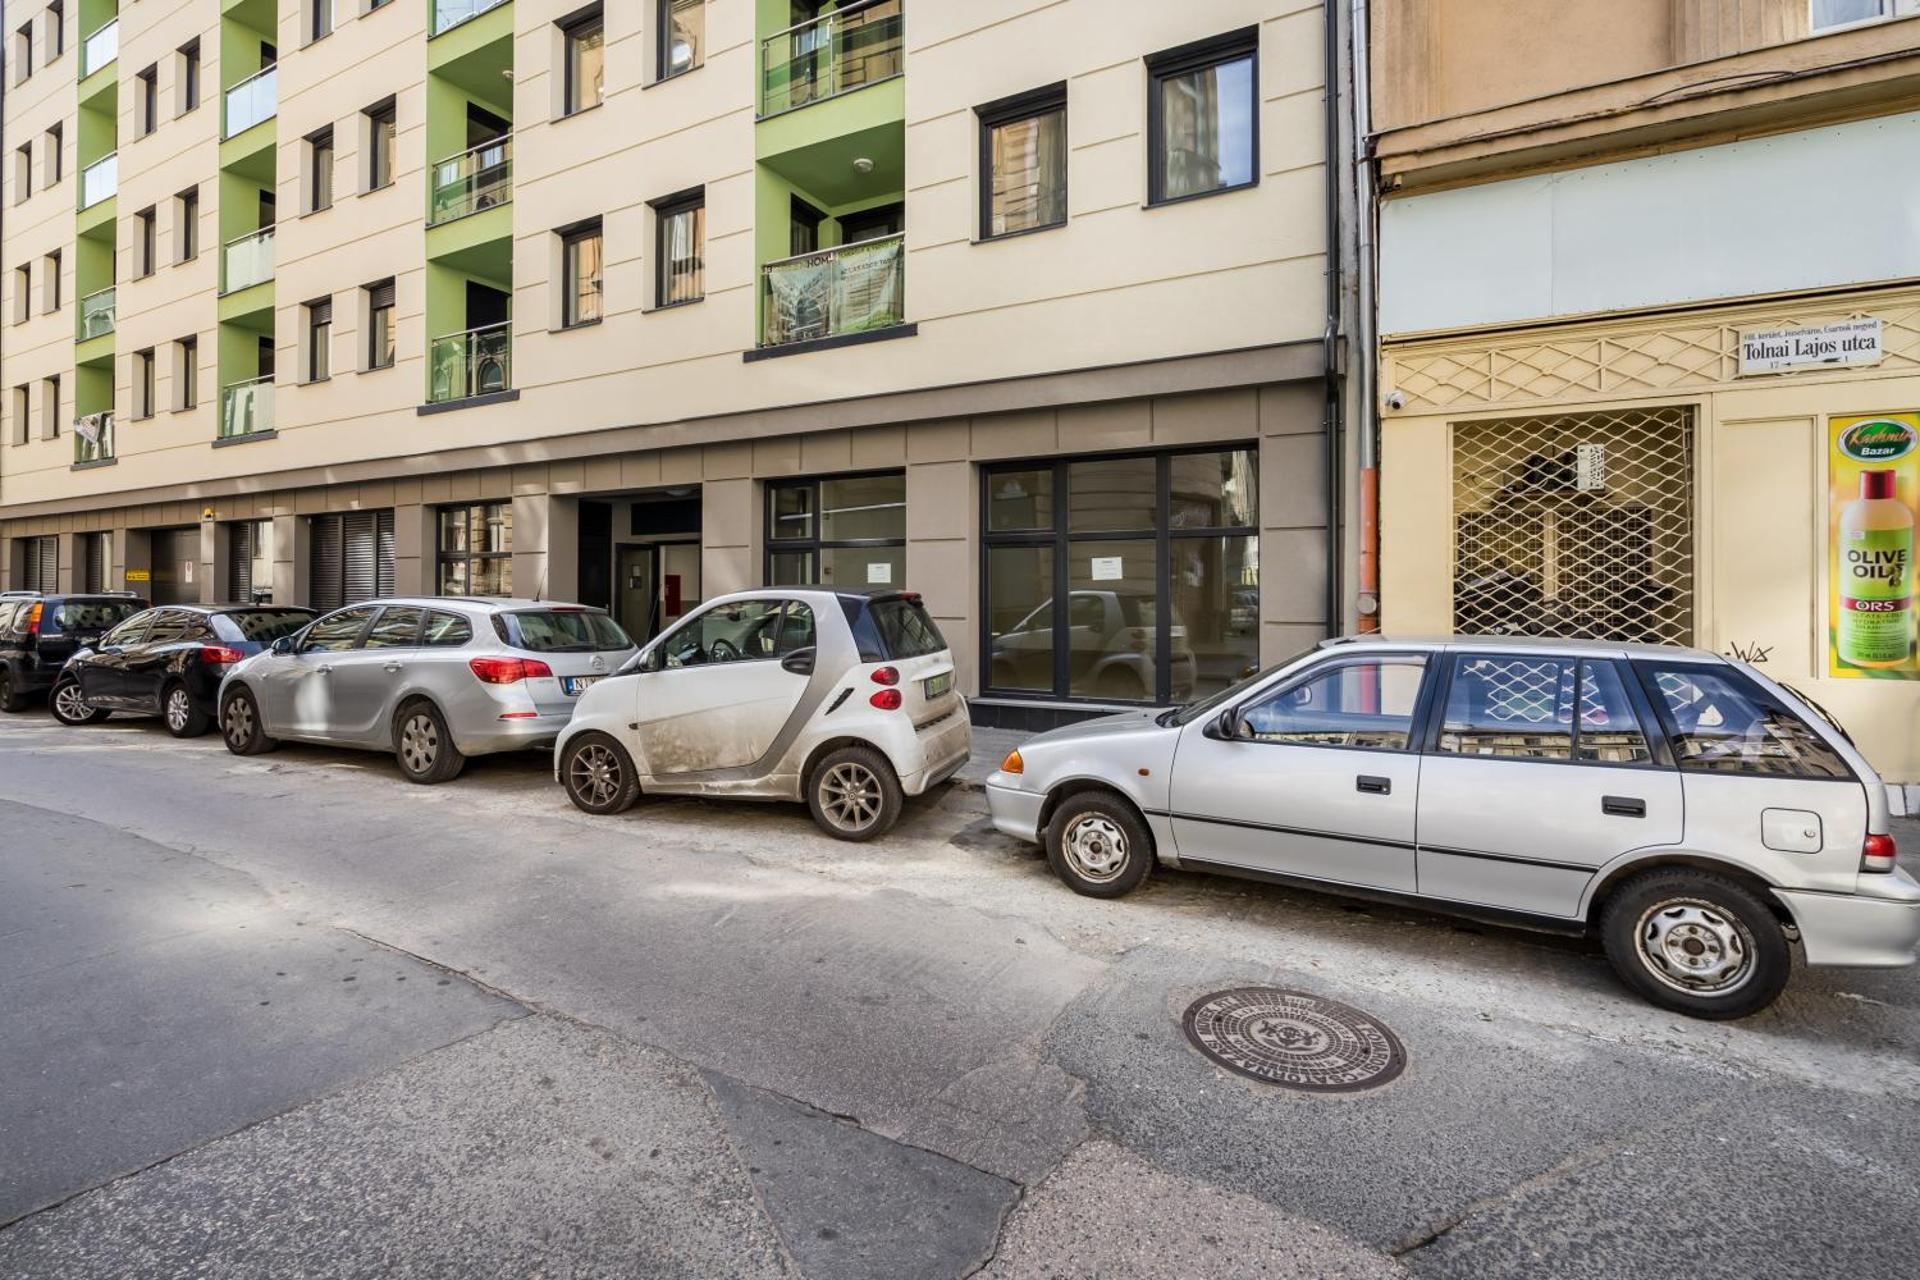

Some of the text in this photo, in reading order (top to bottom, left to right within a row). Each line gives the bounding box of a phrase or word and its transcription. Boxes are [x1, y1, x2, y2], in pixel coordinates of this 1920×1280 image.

[1744, 335, 1877, 360] Tolnai Lajos utca
[1769, 361, 1779, 369] 17
[1861, 447, 1895, 456] Bazar
[1848, 549, 1907, 564] OLIVE
[1853, 565, 1889, 578] OIL
[1855, 600, 1895, 612] ORS
